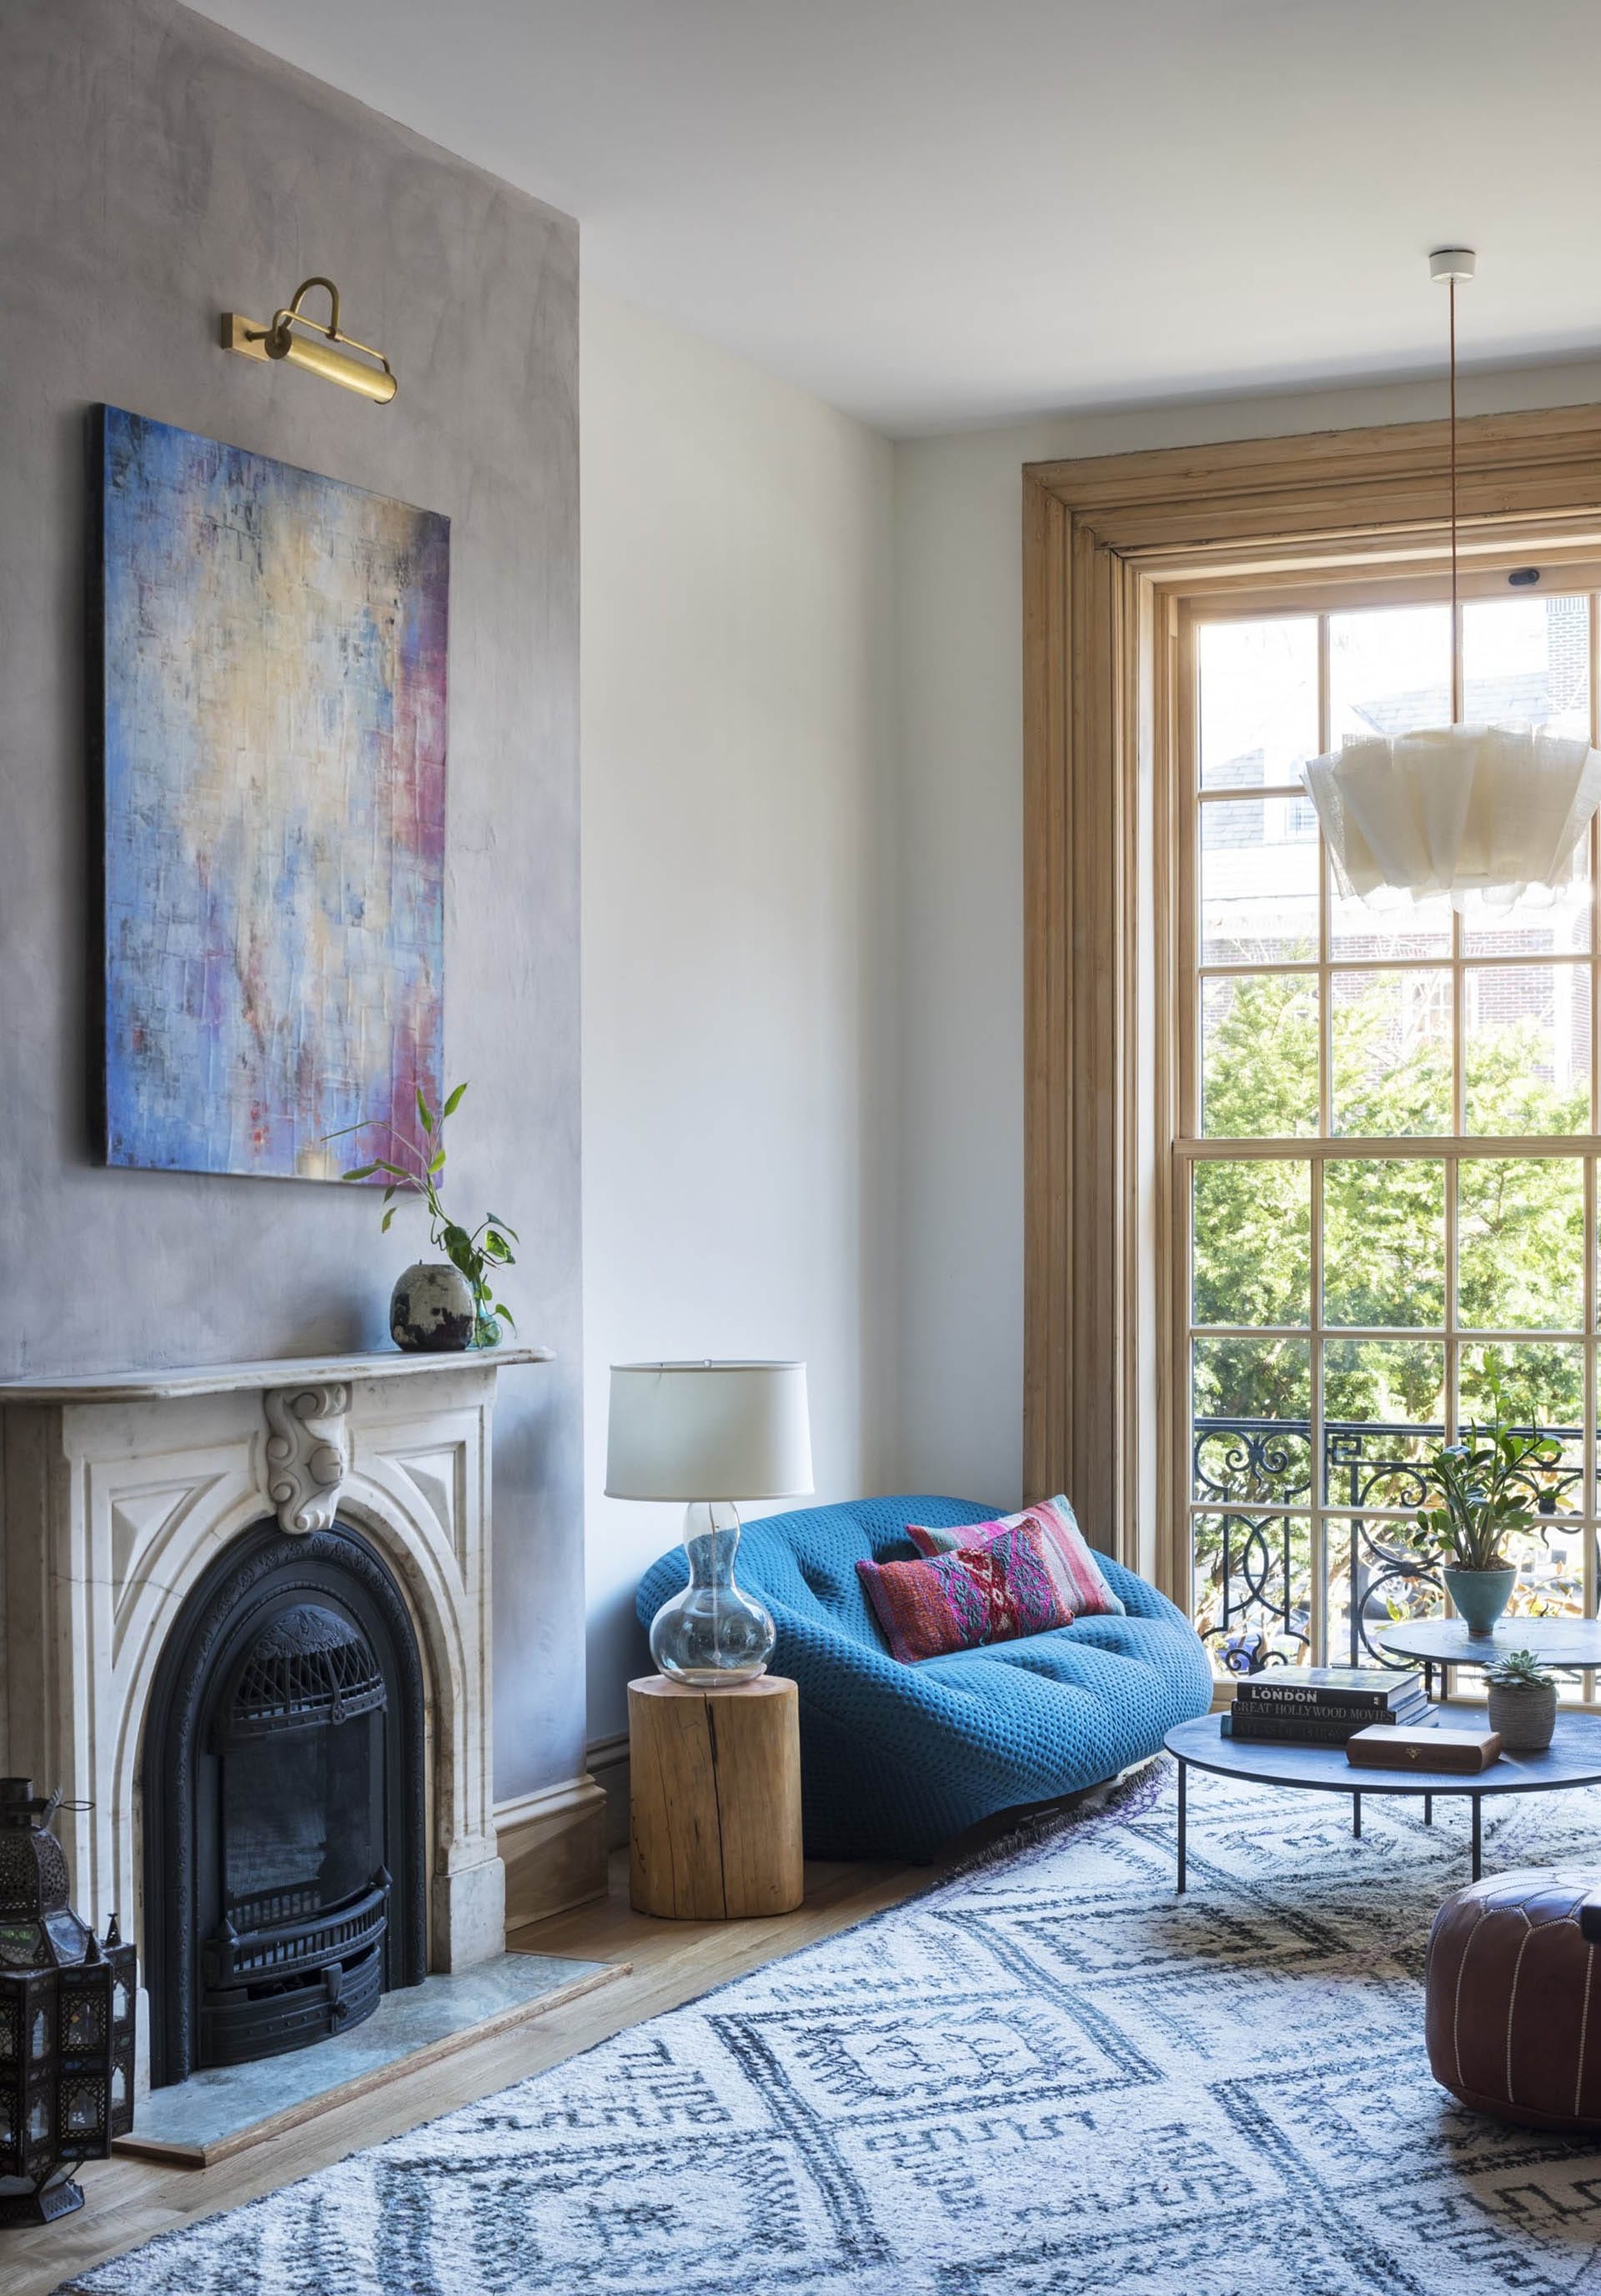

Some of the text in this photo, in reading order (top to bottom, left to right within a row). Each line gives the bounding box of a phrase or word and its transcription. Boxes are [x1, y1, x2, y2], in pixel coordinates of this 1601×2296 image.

[1252, 1689, 1317, 1703] LONDON
[1233, 1701, 1395, 1722] GREAT HOLLYWOOD MOVIES
